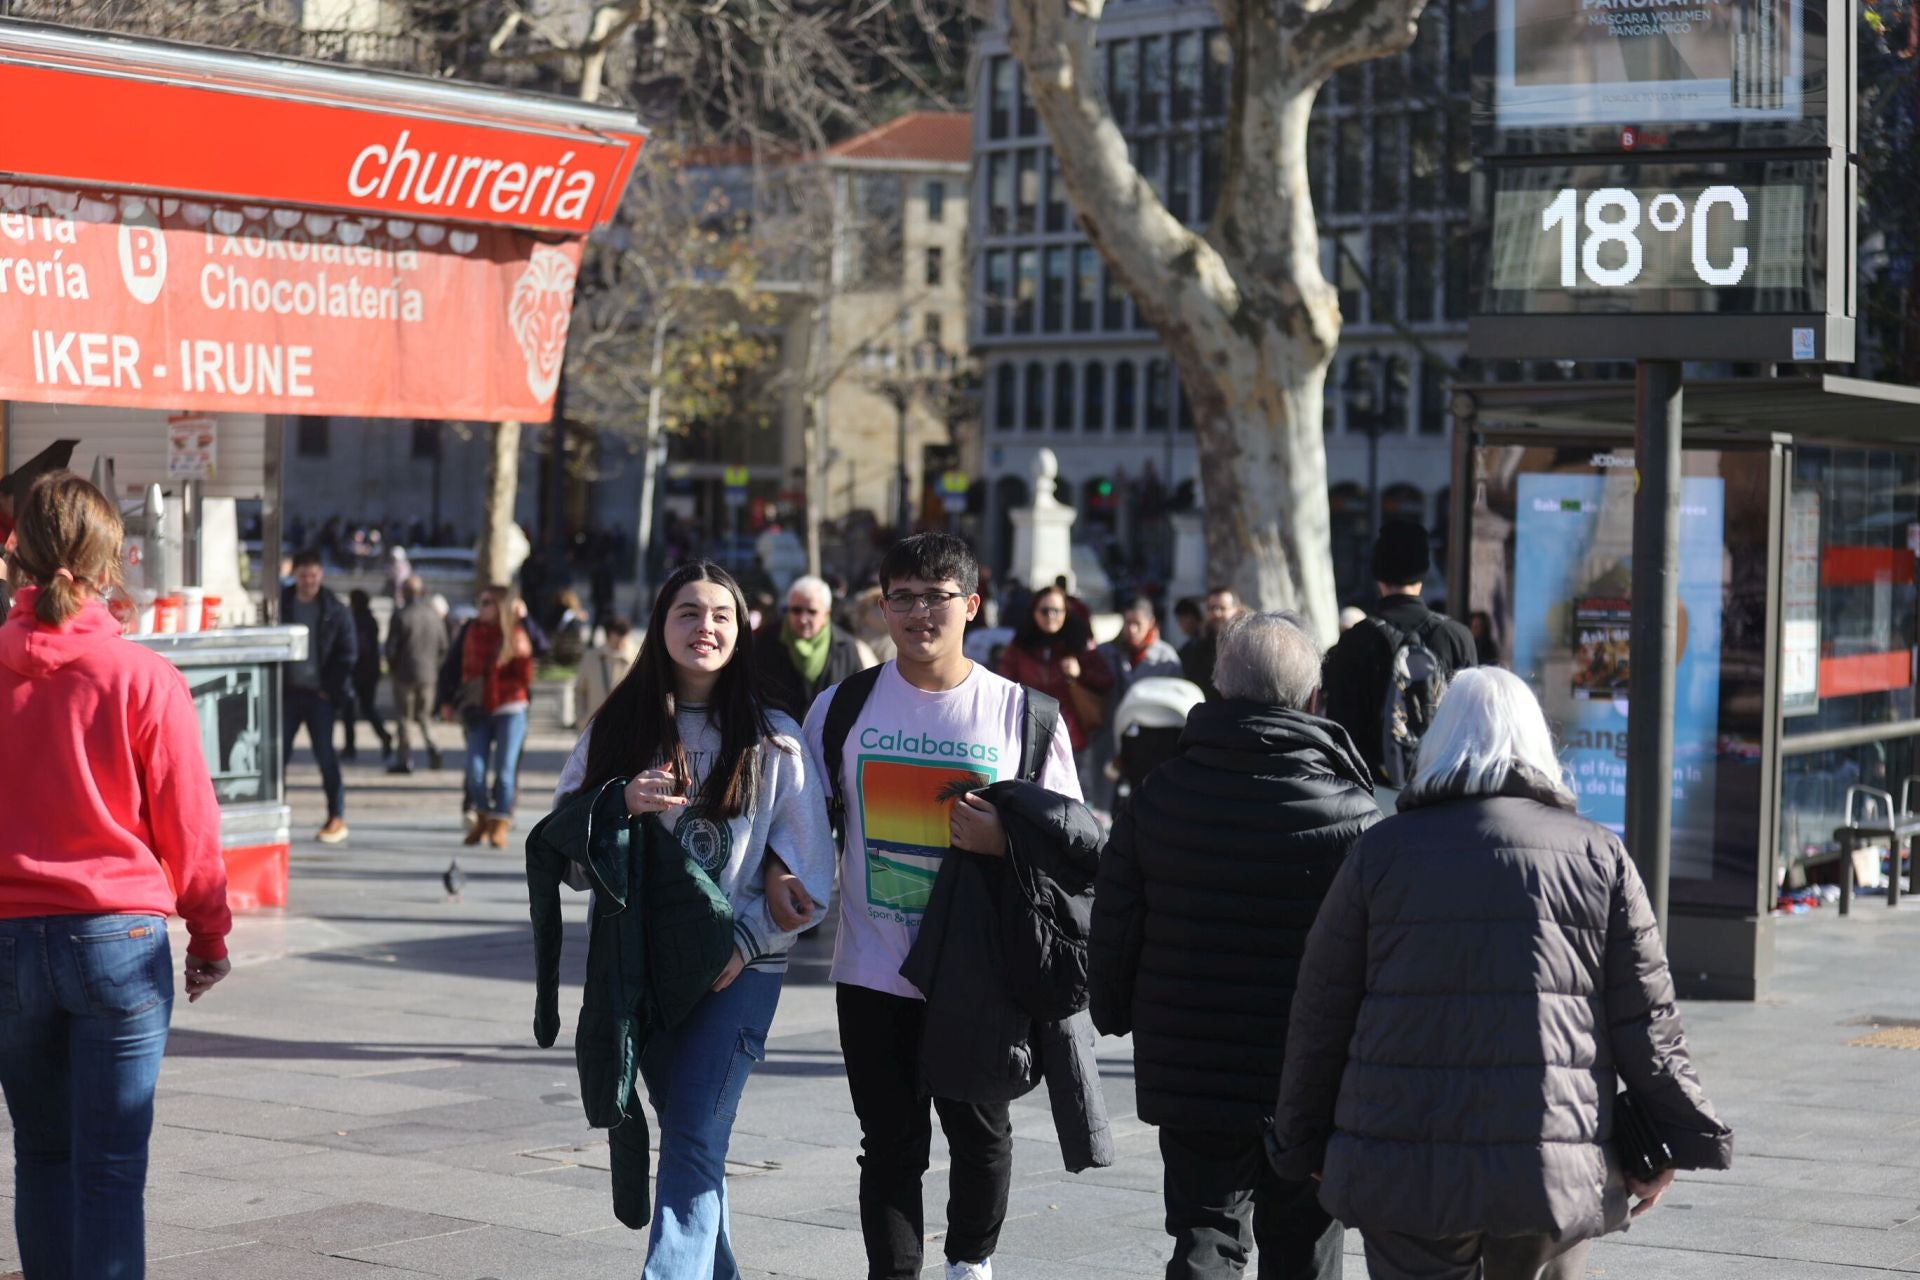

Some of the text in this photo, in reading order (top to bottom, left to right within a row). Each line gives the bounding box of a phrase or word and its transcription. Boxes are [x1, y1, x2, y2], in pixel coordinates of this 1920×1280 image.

[347, 129, 596, 220] churrería
[200, 263, 423, 322] Chocolatería
[31, 330, 142, 389] IKER
[180, 339, 315, 397] IRUNE
[859, 727, 999, 763] Calabasas
[1586, 779, 1607, 795] de
